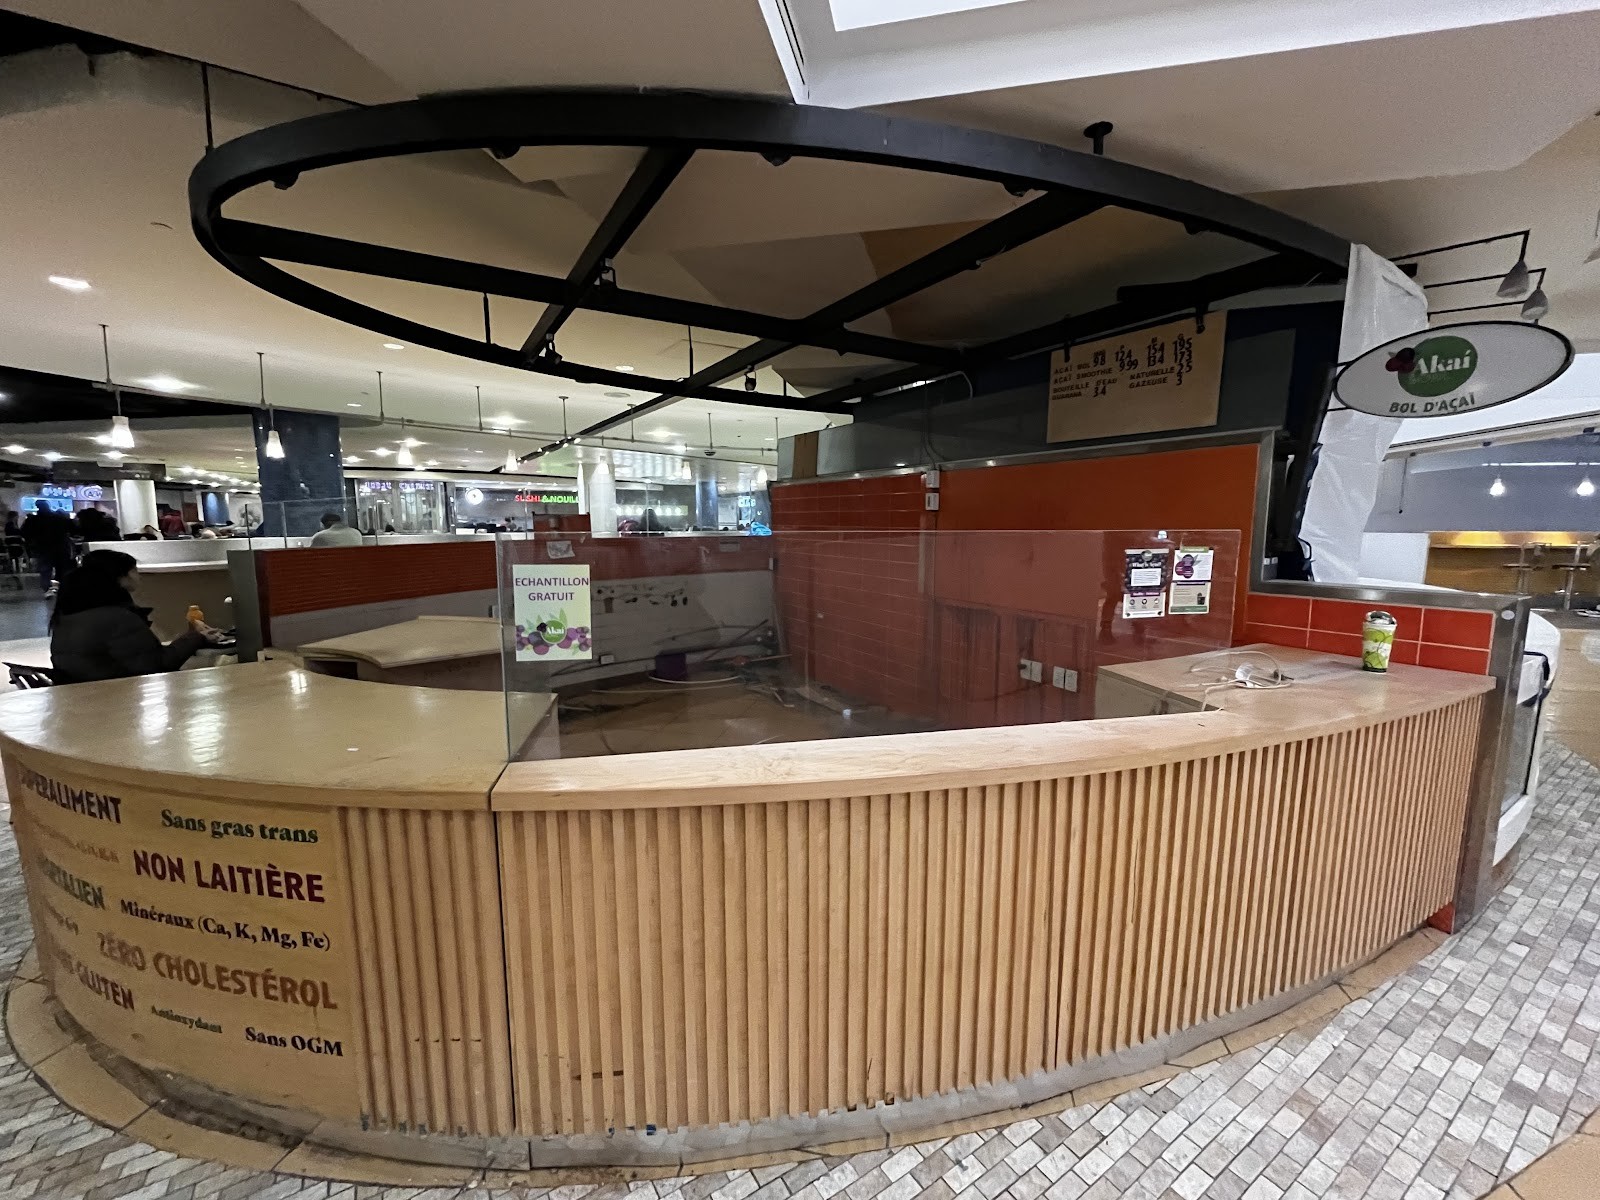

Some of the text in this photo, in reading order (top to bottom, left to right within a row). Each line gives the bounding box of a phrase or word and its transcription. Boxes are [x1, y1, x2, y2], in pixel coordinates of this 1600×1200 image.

[1053, 382, 1090, 394] BOUTEILLE
[1129, 366, 1175, 380] NATURELLE
[1076, 367, 1113, 380] SMOOTHIE
[1129, 377, 1168, 389] GAZEUSE
[1389, 402, 1417, 413] BOL
[515, 577, 589, 587] ECHANTILLON
[528, 592, 575, 602] GRATUIT
[161, 809, 318, 843] Sans gras trans
[133, 849, 325, 903] NON LAITIÈRE
[120, 899, 331, 952] Minéraux (Ca, K, Mg, Fe)
[152, 951, 338, 1010] CHOLESTÉROL
[245, 1027, 344, 1057] Sans OGM
